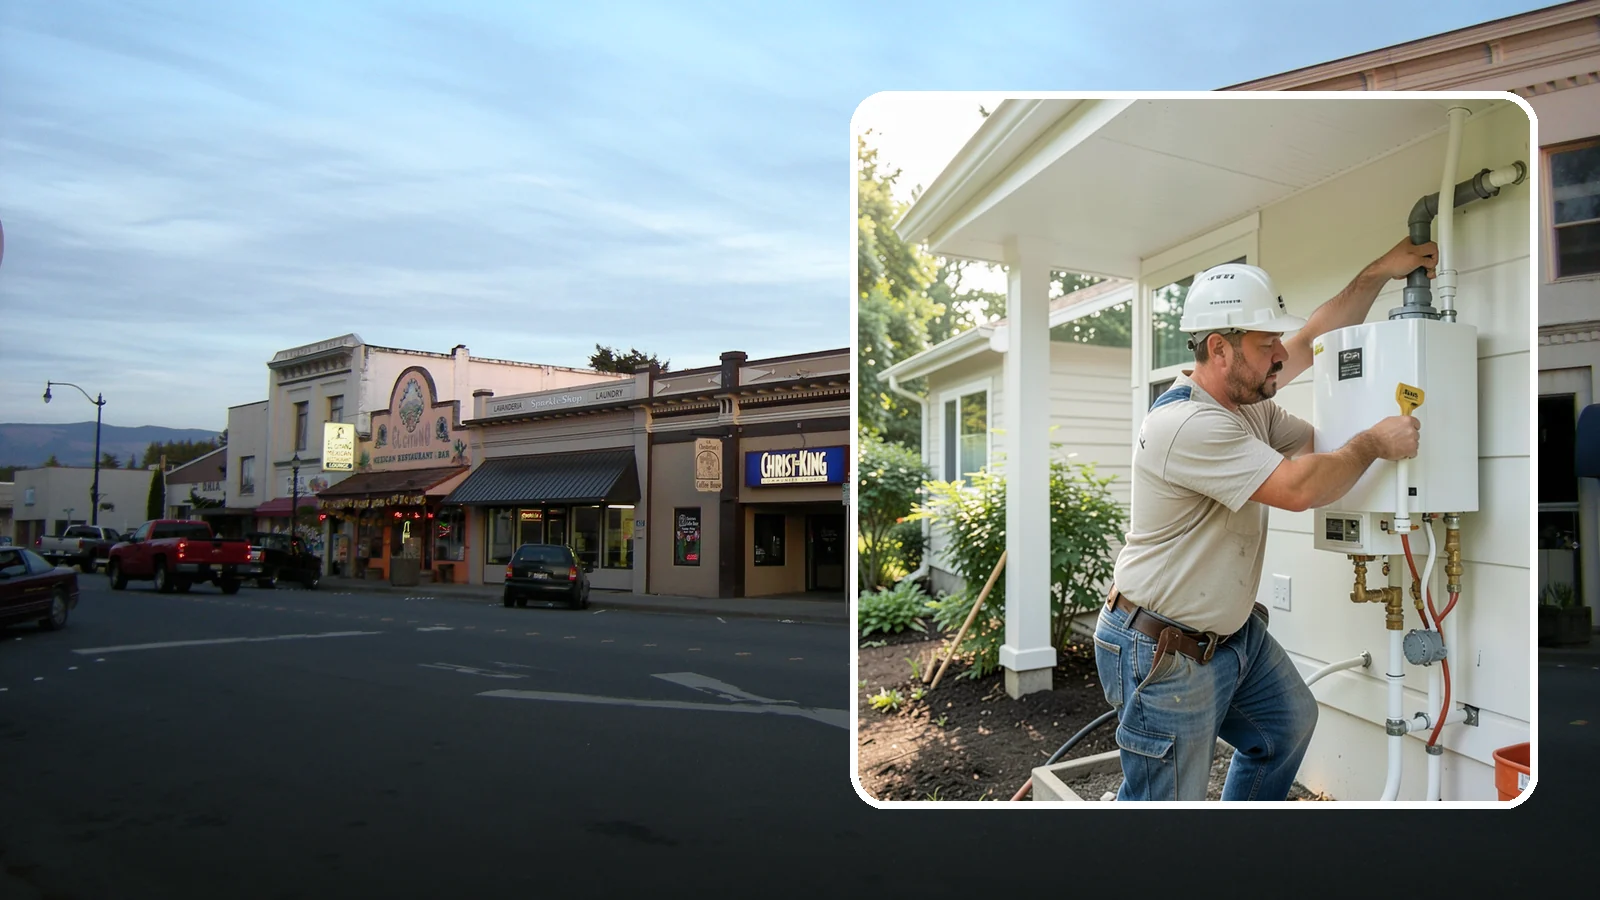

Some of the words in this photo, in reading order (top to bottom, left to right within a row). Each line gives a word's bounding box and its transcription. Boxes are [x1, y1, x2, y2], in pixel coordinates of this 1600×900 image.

[493, 402, 522, 412] LAVANDERIA
[561, 395, 582, 406] Shop
[595, 389, 623, 400] LAUNDRY
[373, 455, 396, 464] MEXICAN
[397, 451, 434, 462] RESTAURANT
[438, 450, 450, 459] BAR
[761, 452, 797, 478] CHRIST
[799, 450, 827, 476] KING
